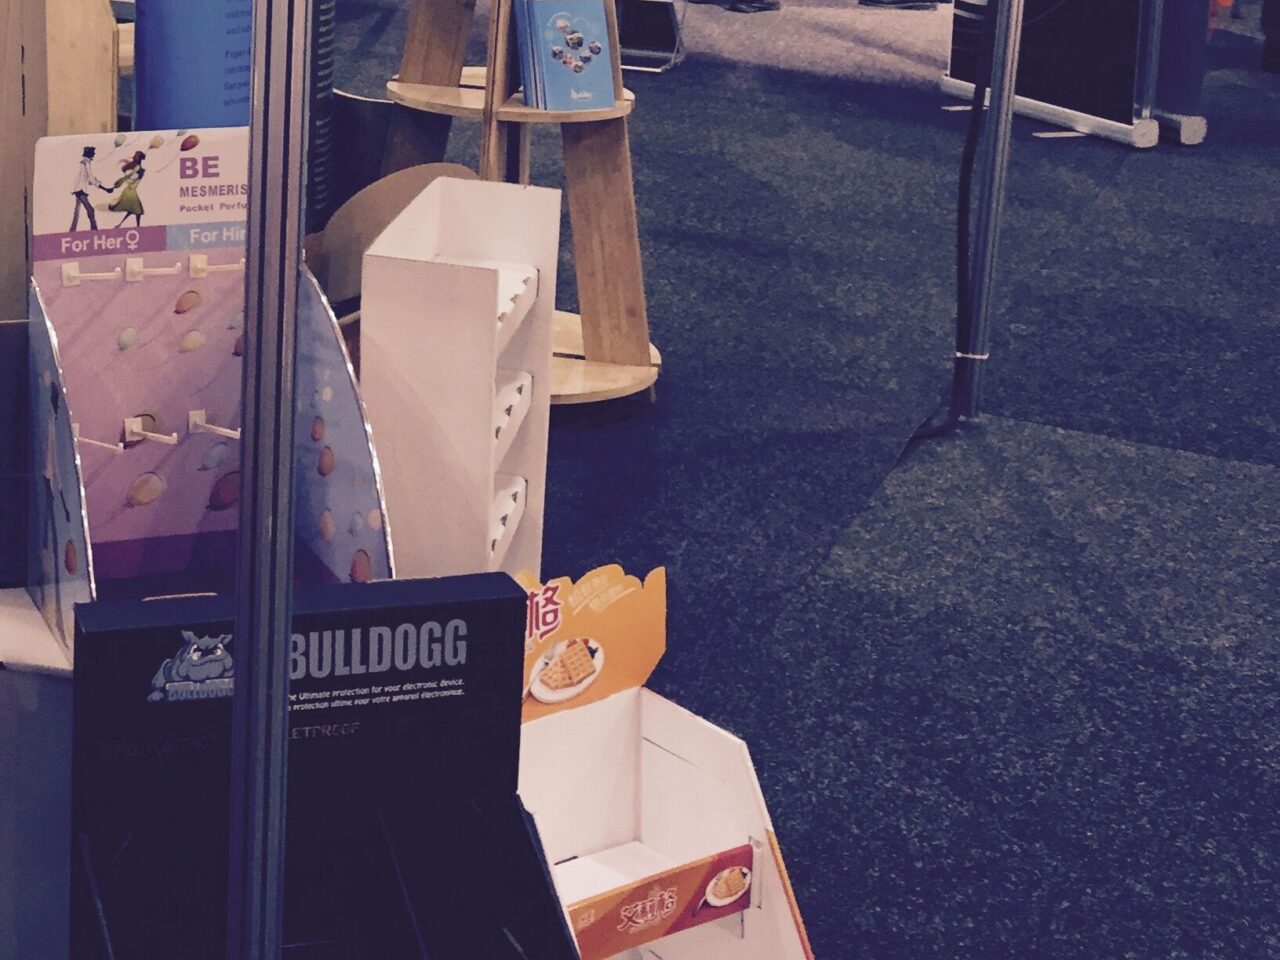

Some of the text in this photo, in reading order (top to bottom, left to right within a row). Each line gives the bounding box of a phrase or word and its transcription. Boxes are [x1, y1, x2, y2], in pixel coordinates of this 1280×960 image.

[180, 156, 220, 179] BE
[179, 204, 214, 213] Pocket
[61, 234, 124, 253] For Her
[190, 228, 218, 244] For
[290, 618, 468, 680] BULLDOGG
[371, 684, 383, 694] for
[287, 722, 361, 740] ETPROOF
